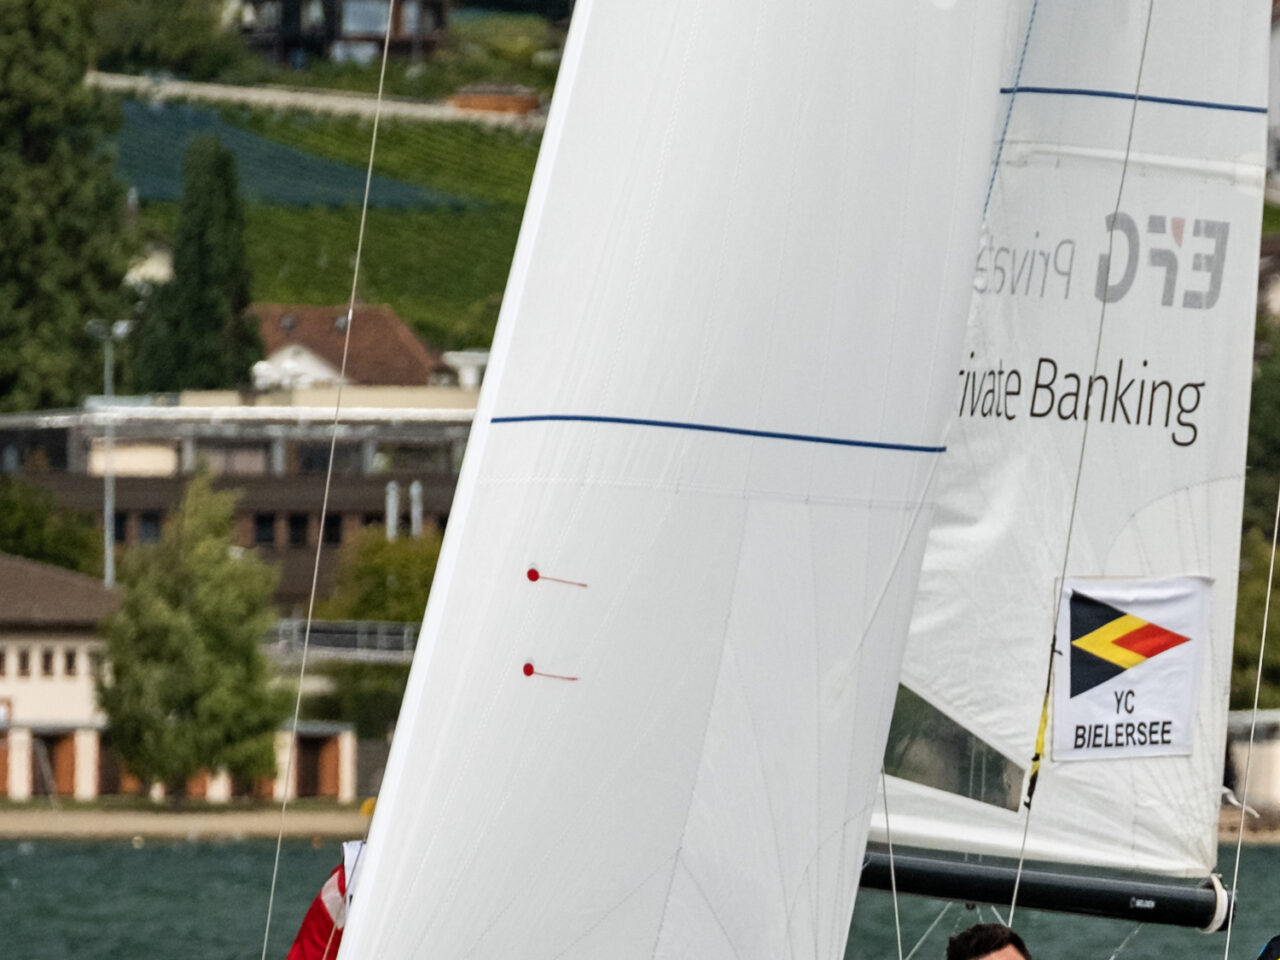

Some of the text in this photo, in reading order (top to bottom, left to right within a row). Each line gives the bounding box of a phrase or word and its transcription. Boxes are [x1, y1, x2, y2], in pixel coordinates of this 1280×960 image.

[959, 351, 1205, 447] ivate Banking
[1114, 689, 1135, 714] YC
[1073, 720, 1173, 749] BIELERSEE
